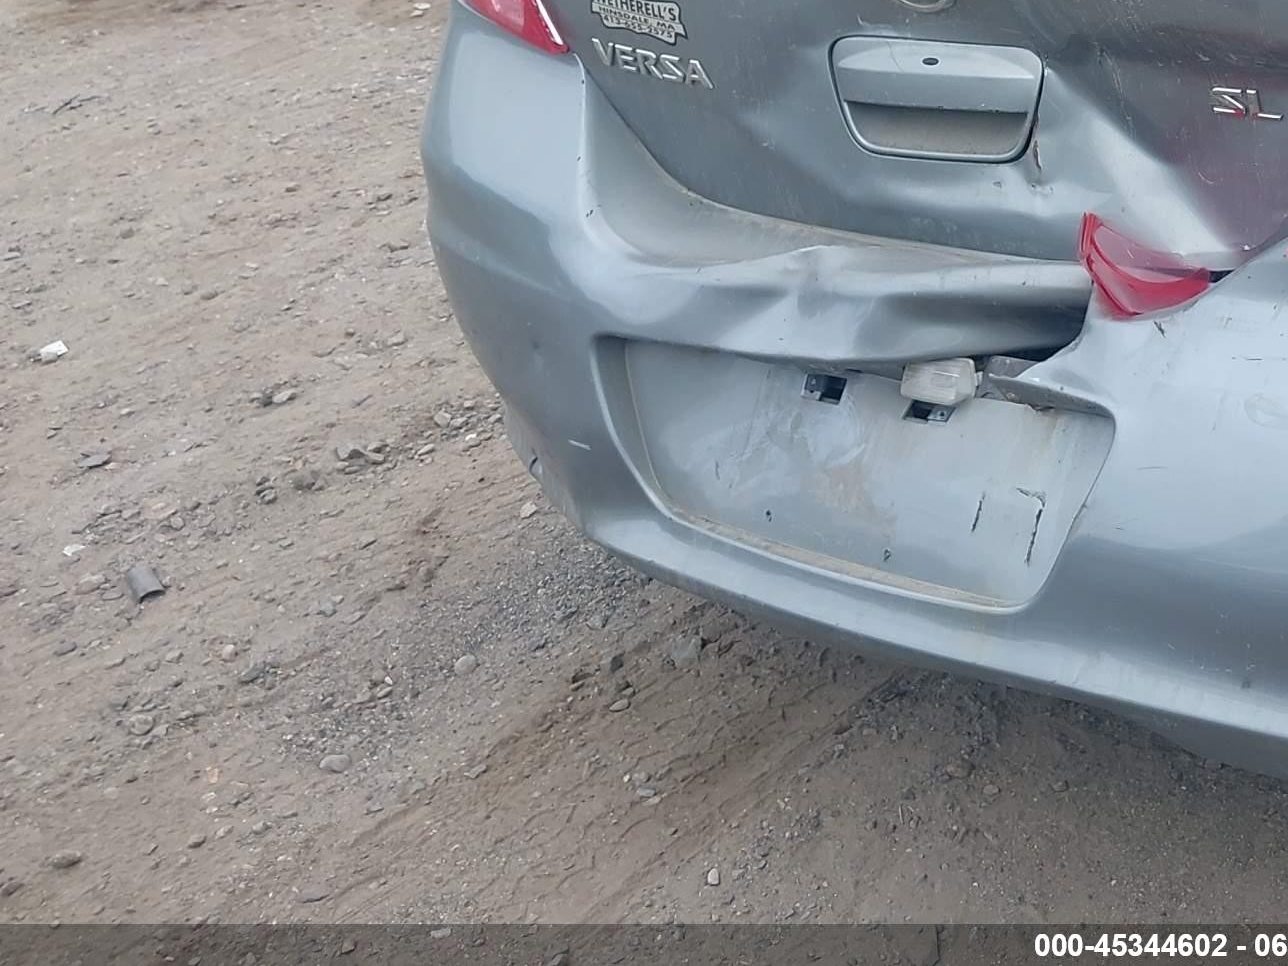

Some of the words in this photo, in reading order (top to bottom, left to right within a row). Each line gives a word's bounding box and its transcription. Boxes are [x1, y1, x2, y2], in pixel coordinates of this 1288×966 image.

[657, 21, 676, 32] MA
[592, 38, 715, 89] VERSA
[1211, 87, 1284, 121] SL
